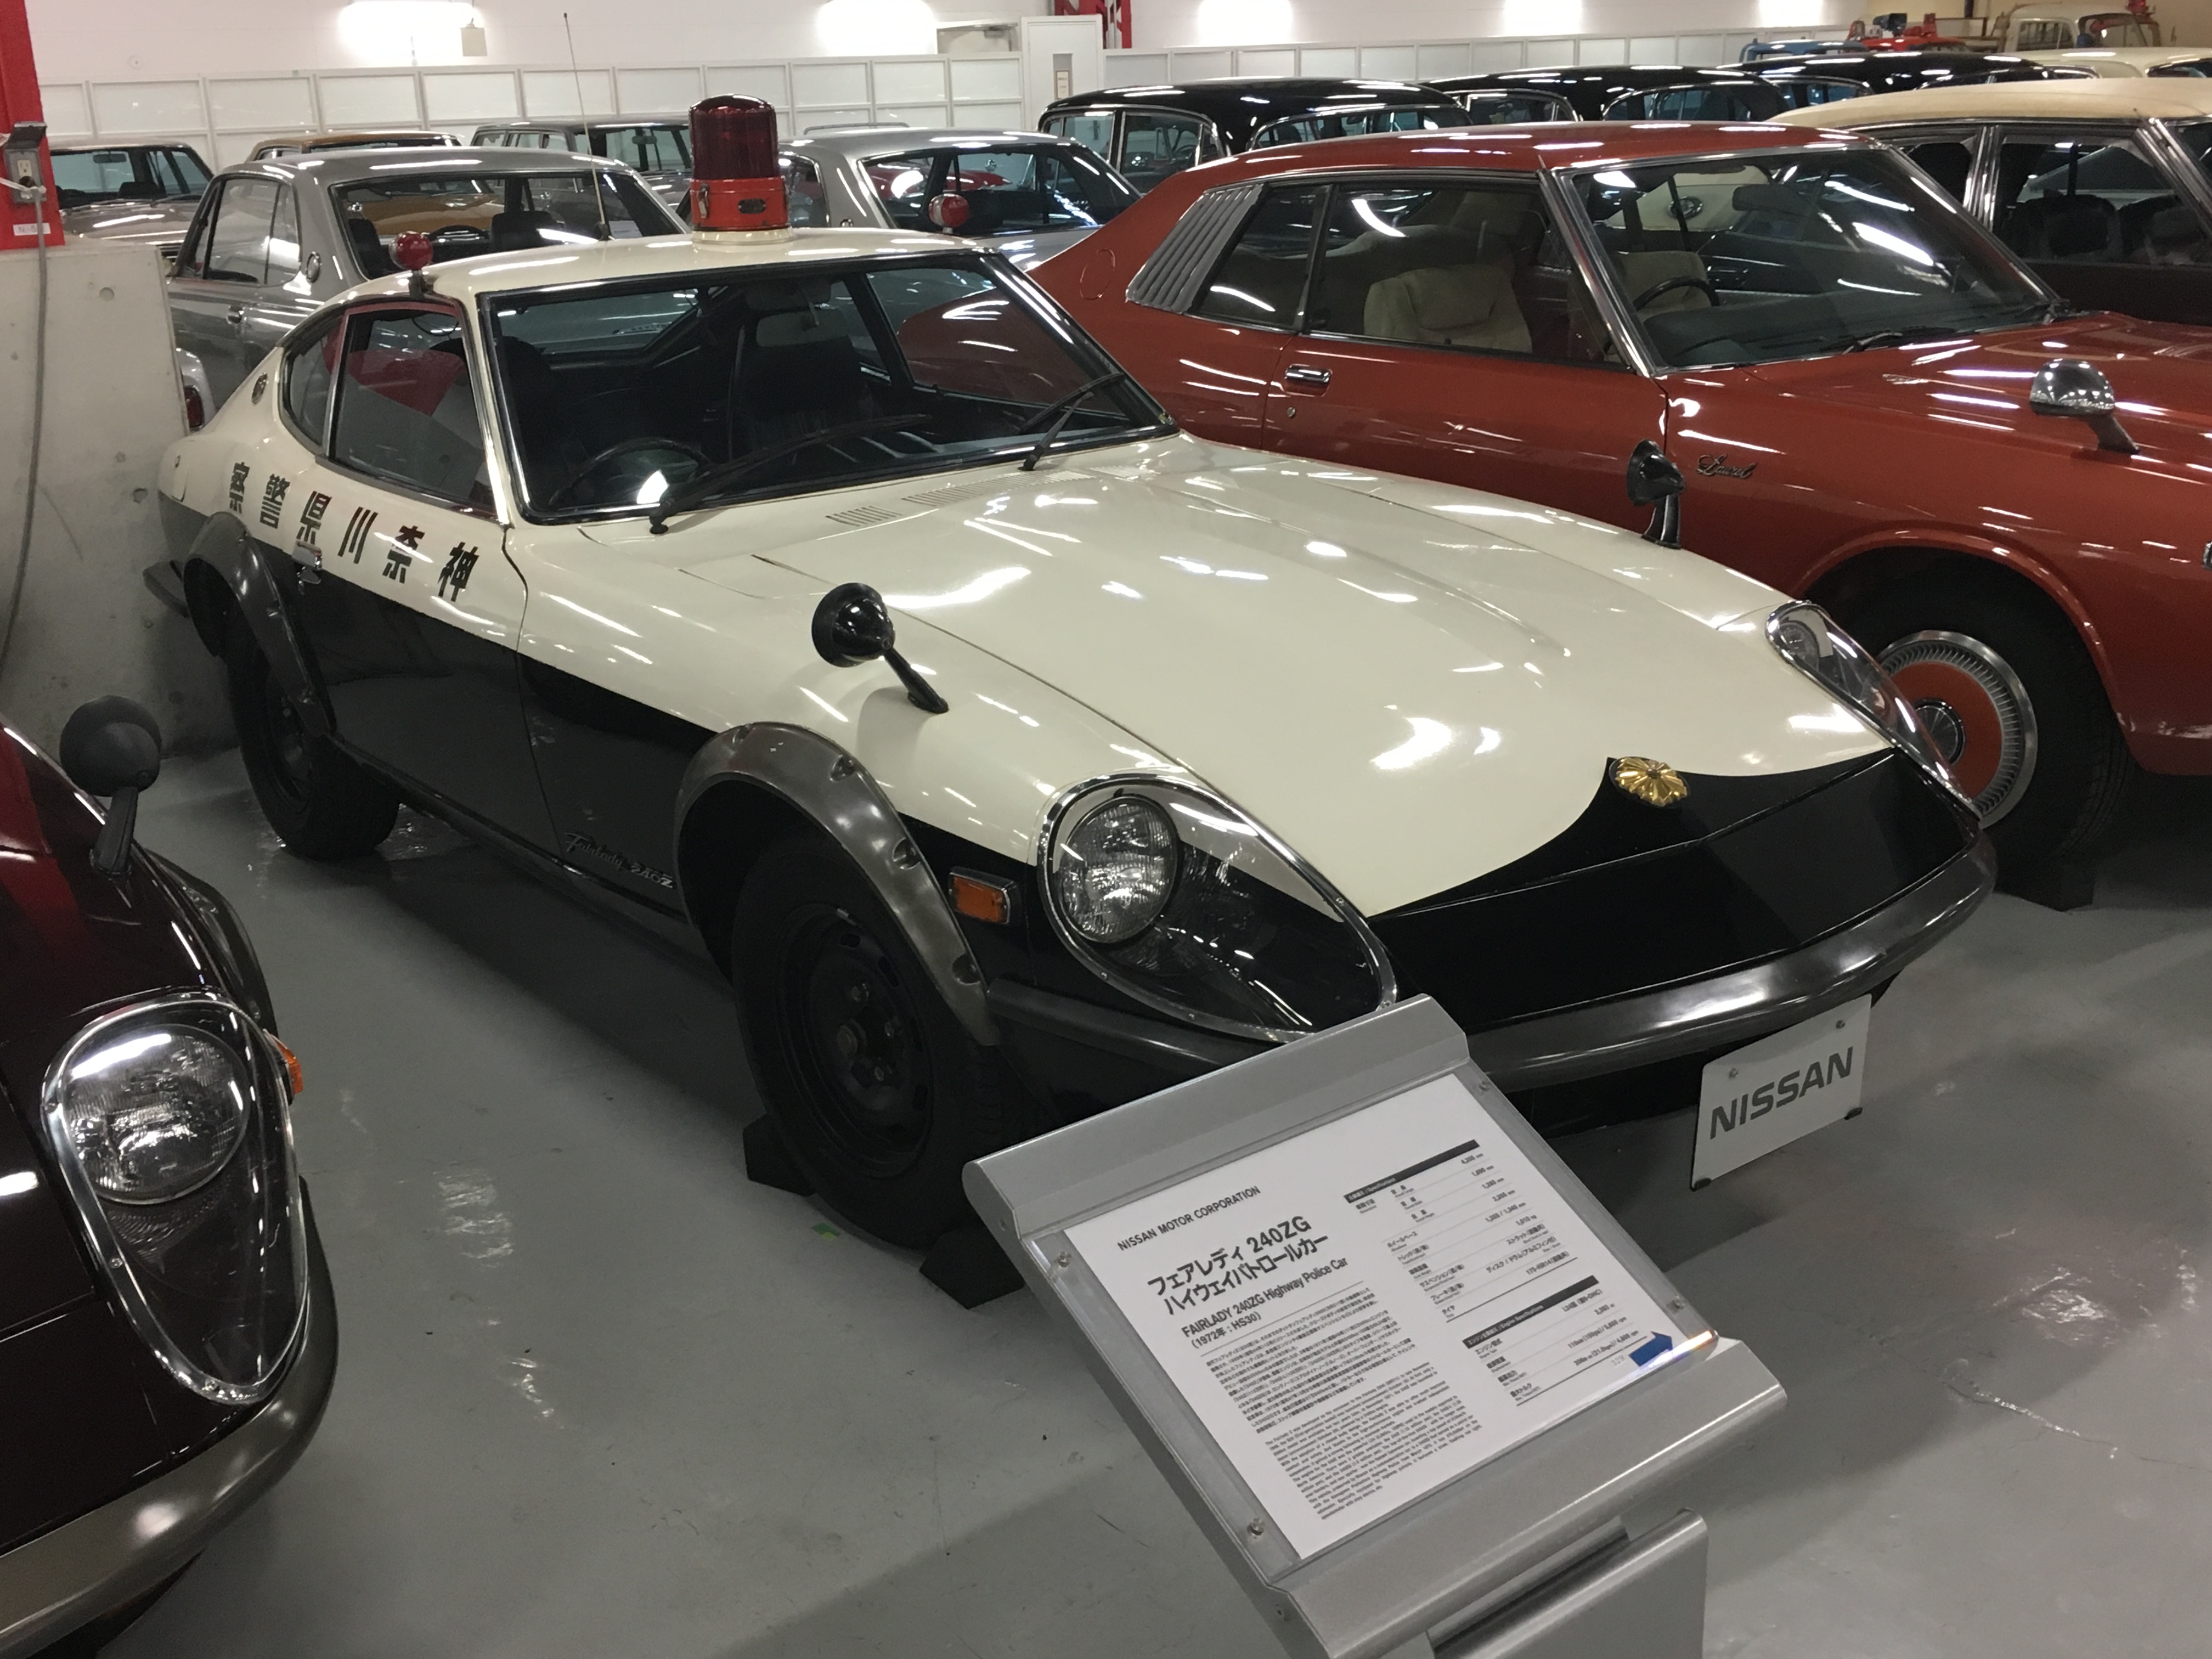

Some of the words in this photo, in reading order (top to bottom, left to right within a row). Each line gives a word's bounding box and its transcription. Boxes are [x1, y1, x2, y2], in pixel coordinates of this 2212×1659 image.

[1696, 453, 1757, 478] Laurel
[1709, 1046, 1853, 1140] NISSAN
[1116, 1228, 1158, 1251] NISSAN
[1156, 1213, 1194, 1234] MOTOR
[1193, 1185, 1261, 1218] CORPORATION
[1147, 1245, 1244, 1296] フェアレディ
[1245, 1215, 1312, 1254] 240ZG
[1163, 1235, 1328, 1316] ハイウェイパトロールカー
[1181, 1306, 1233, 1338] FAIRLADY
[1232, 1293, 1266, 1314] 240ZG
[1262, 1277, 1305, 1301] Highway
[1301, 1265, 1333, 1283] Police
[1329, 1257, 1348, 1270] Car
